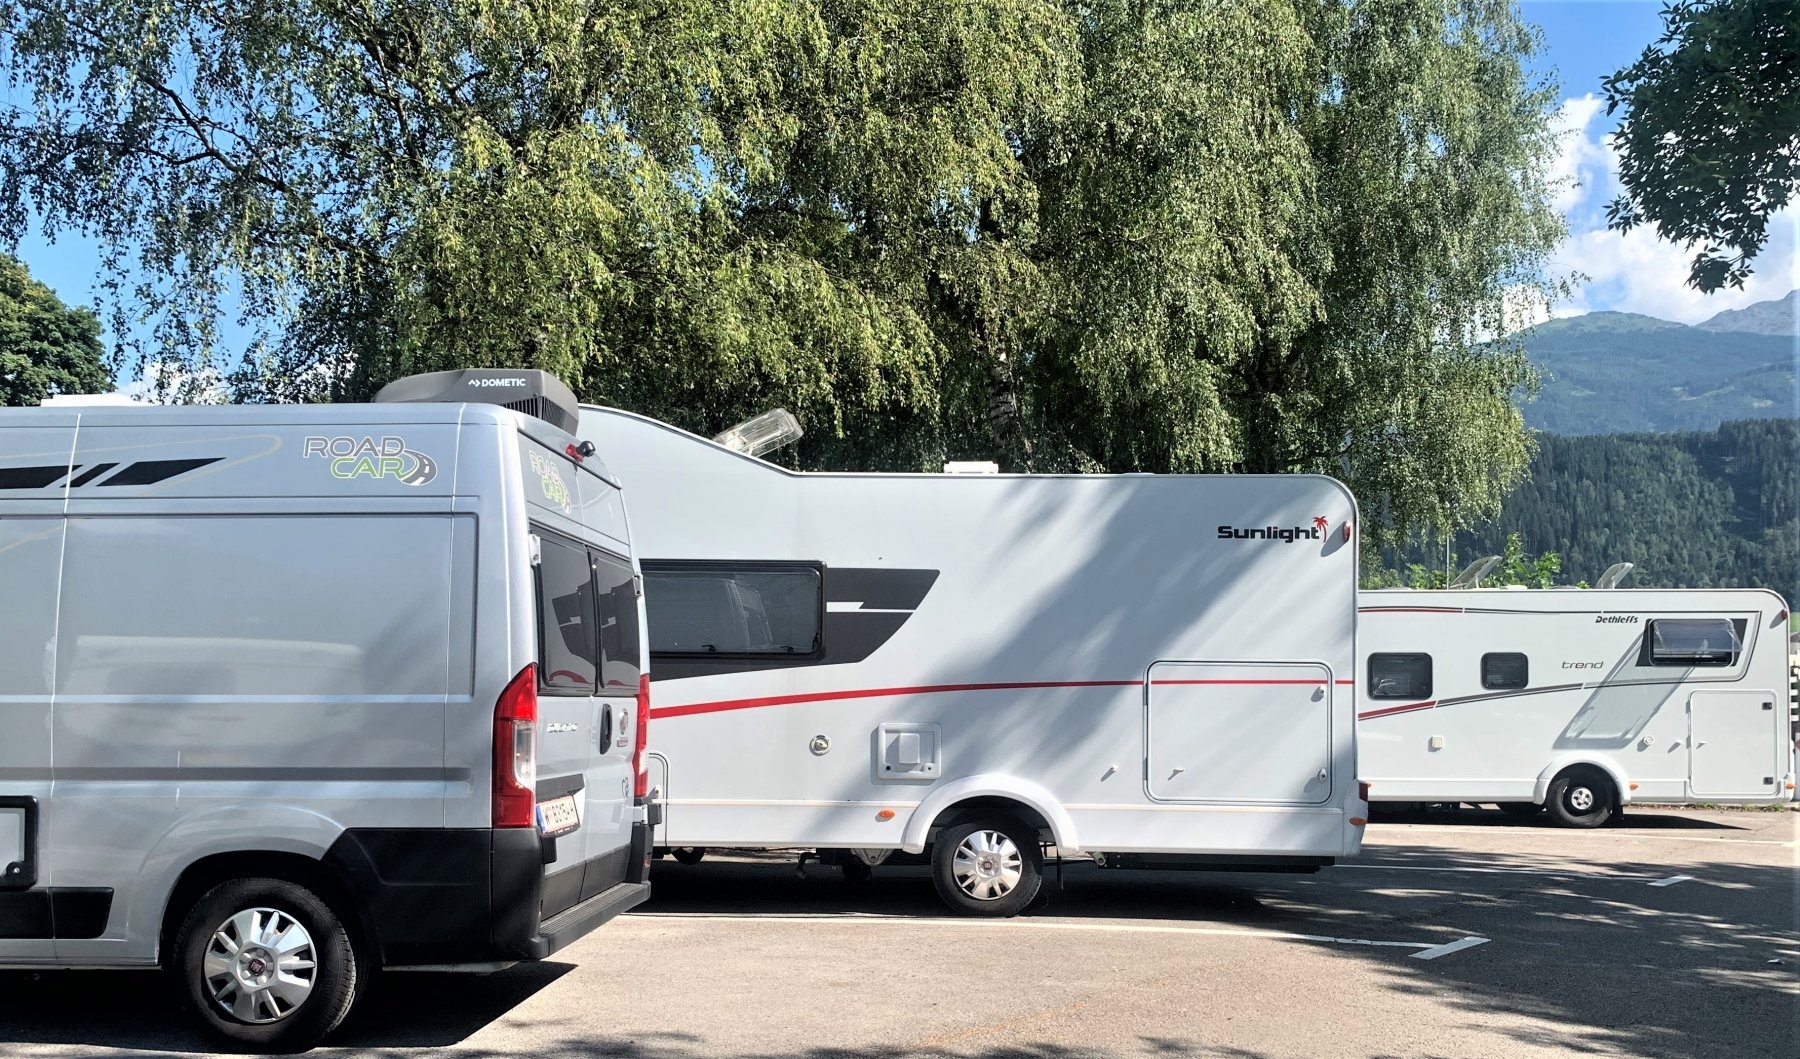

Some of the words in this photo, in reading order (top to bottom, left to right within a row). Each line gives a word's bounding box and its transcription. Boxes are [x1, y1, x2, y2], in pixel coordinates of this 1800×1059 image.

[481, 378, 526, 387] DOMETIC
[303, 436, 406, 458] ROAD
[330, 456, 405, 481] CAR
[1217, 525, 1320, 544] Sunlight
[1595, 615, 1638, 624] Dethleffs
[1561, 660, 1604, 669] trend
